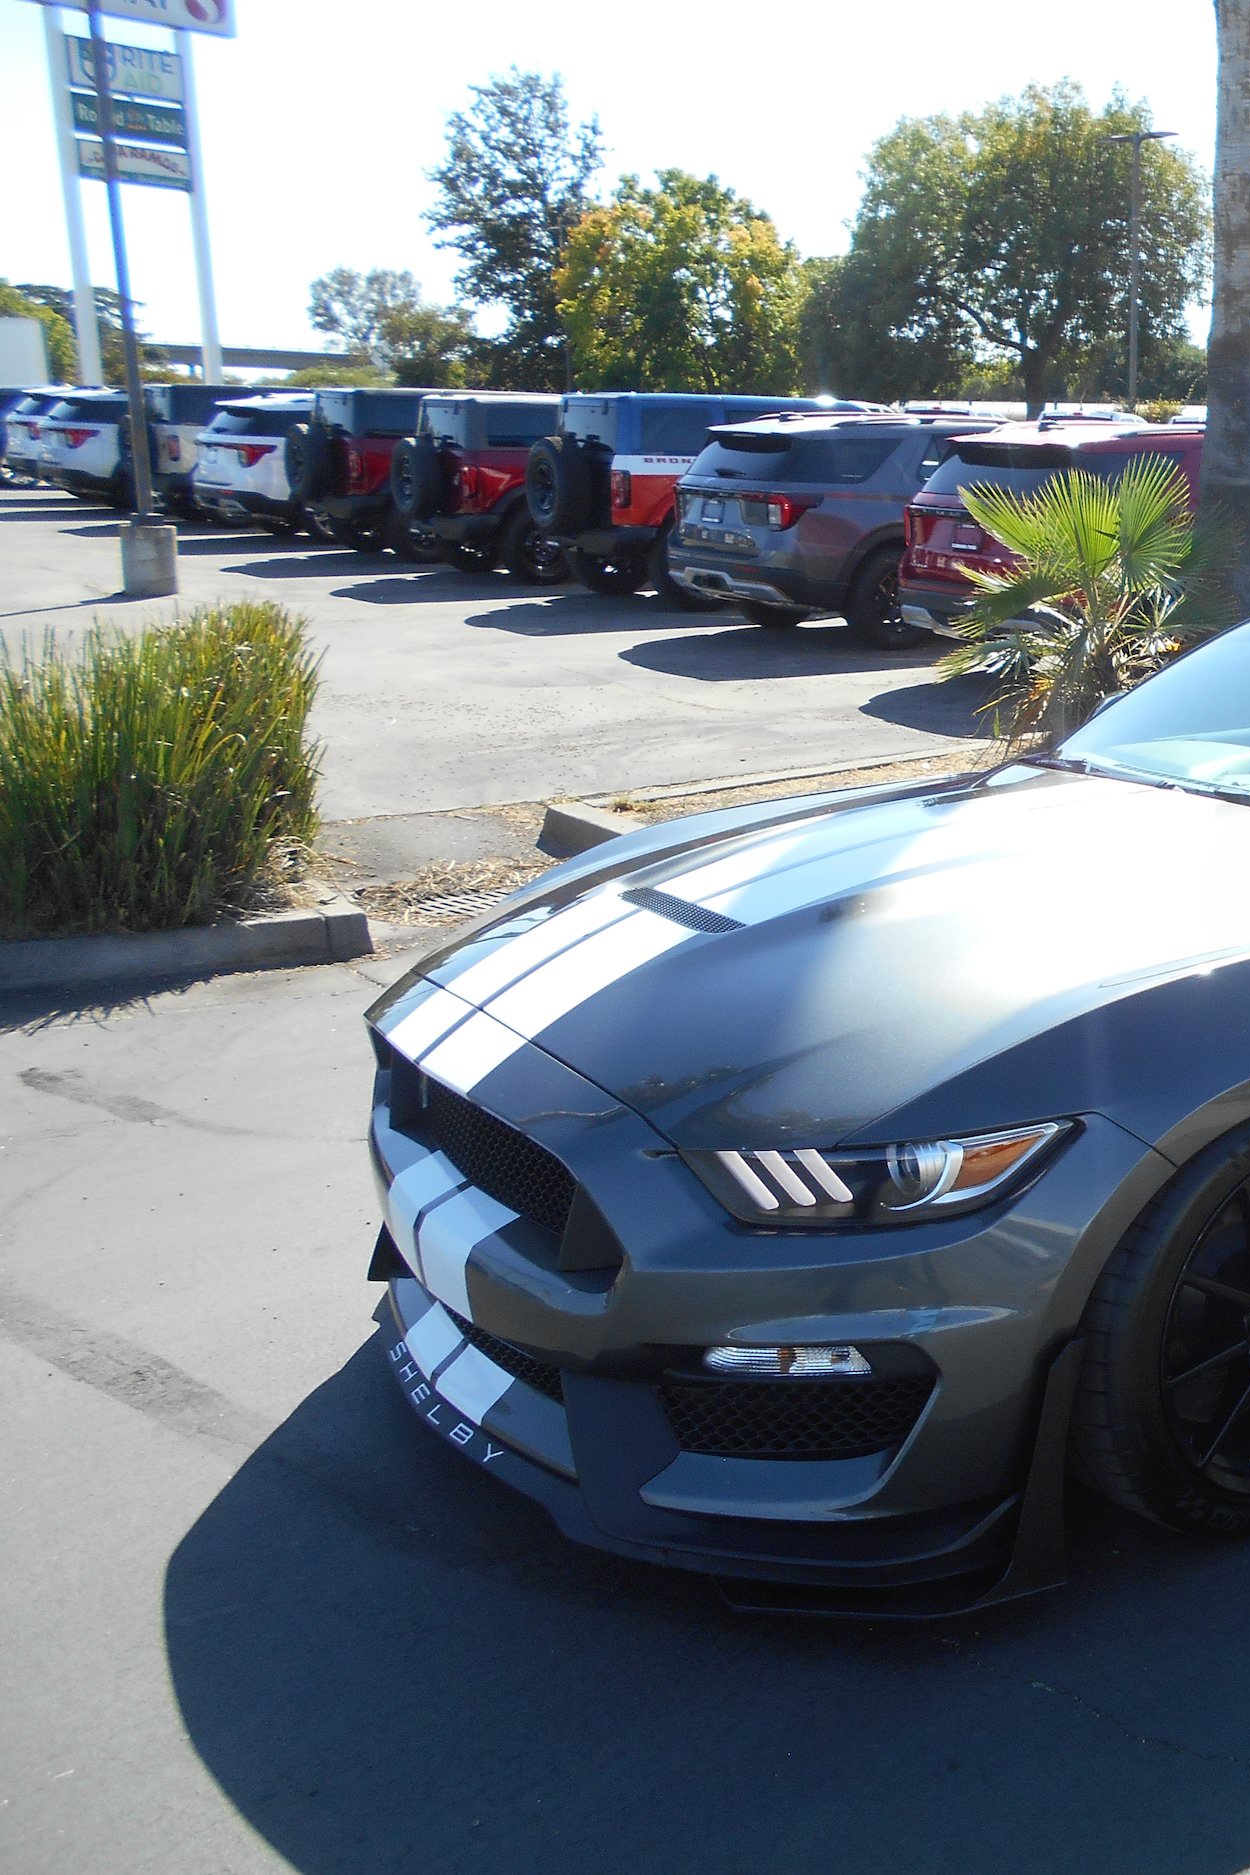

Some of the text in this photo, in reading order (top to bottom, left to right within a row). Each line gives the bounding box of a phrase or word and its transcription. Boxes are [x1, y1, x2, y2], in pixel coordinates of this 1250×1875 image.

[121, 46, 175, 75] RITE
[125, 72, 163, 93] AID
[78, 102, 186, 137] Rod Table
[643, 457, 697, 465] BRON
[389, 1341, 505, 1463] SHELBY
